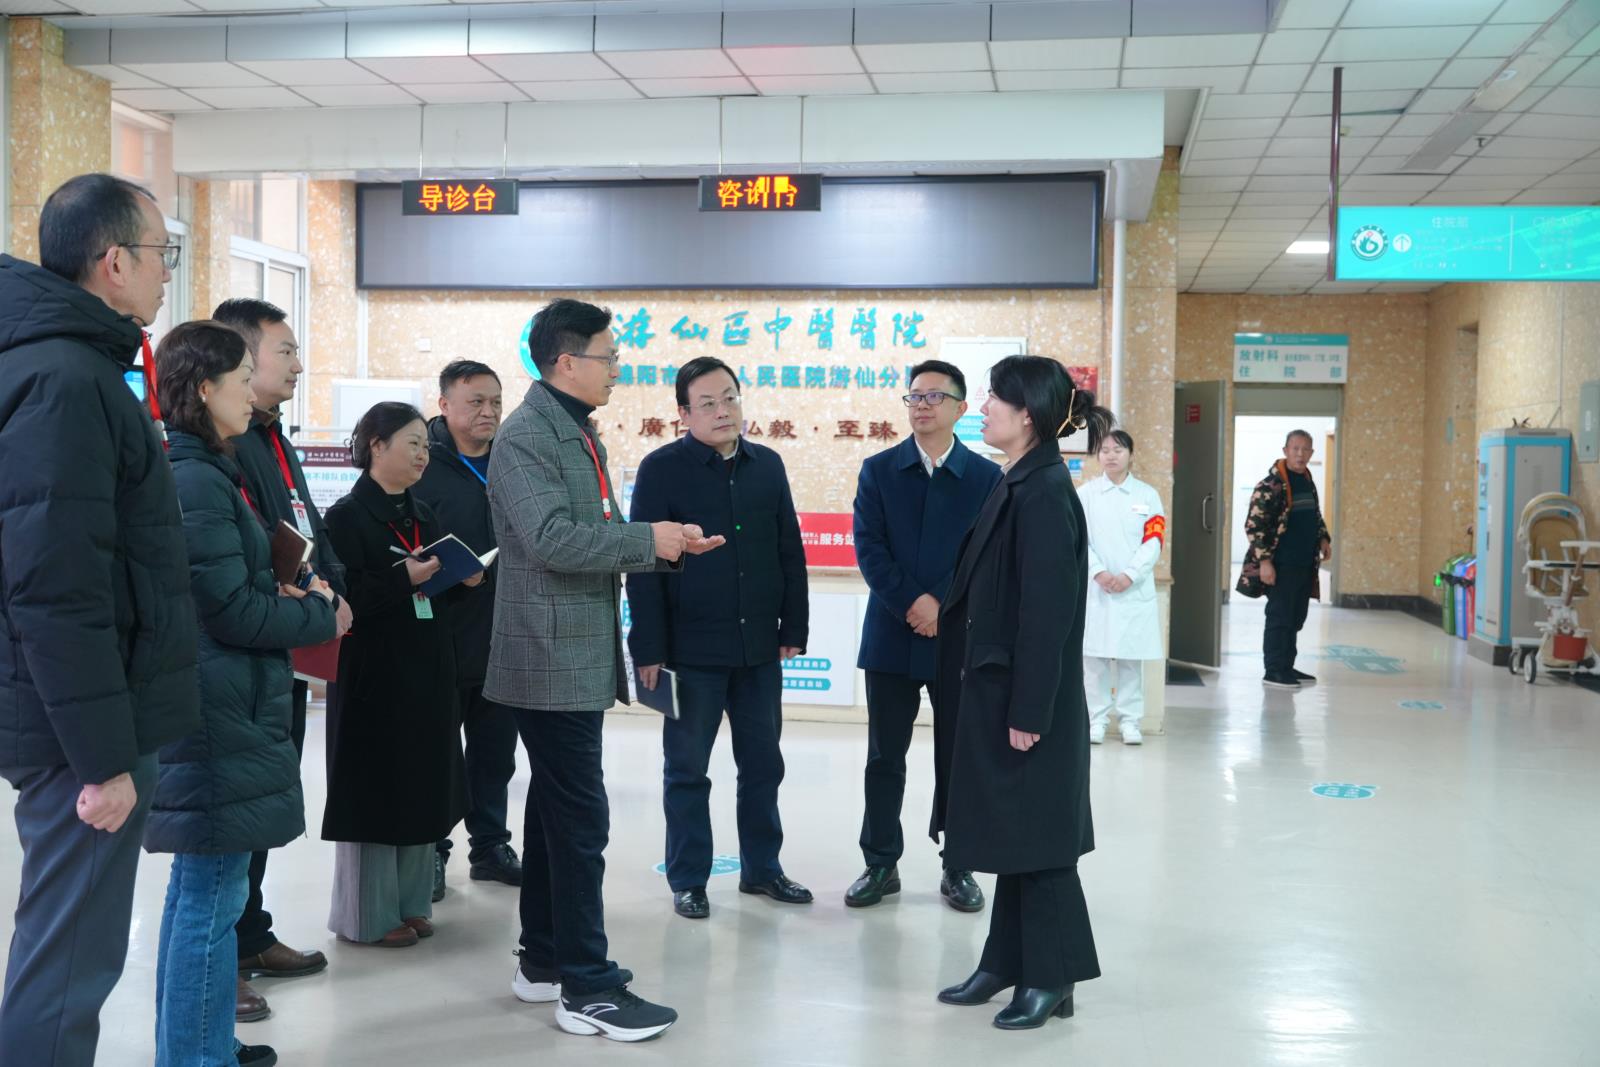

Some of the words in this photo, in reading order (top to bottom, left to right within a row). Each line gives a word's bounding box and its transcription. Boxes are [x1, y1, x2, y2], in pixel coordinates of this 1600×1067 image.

[418, 183, 496, 212] 导诊台
[1240, 349, 1279, 361] 放射科
[616, 363, 911, 389] 绵阳市人民医院游仙分
[1239, 366, 1342, 378] 住院部
